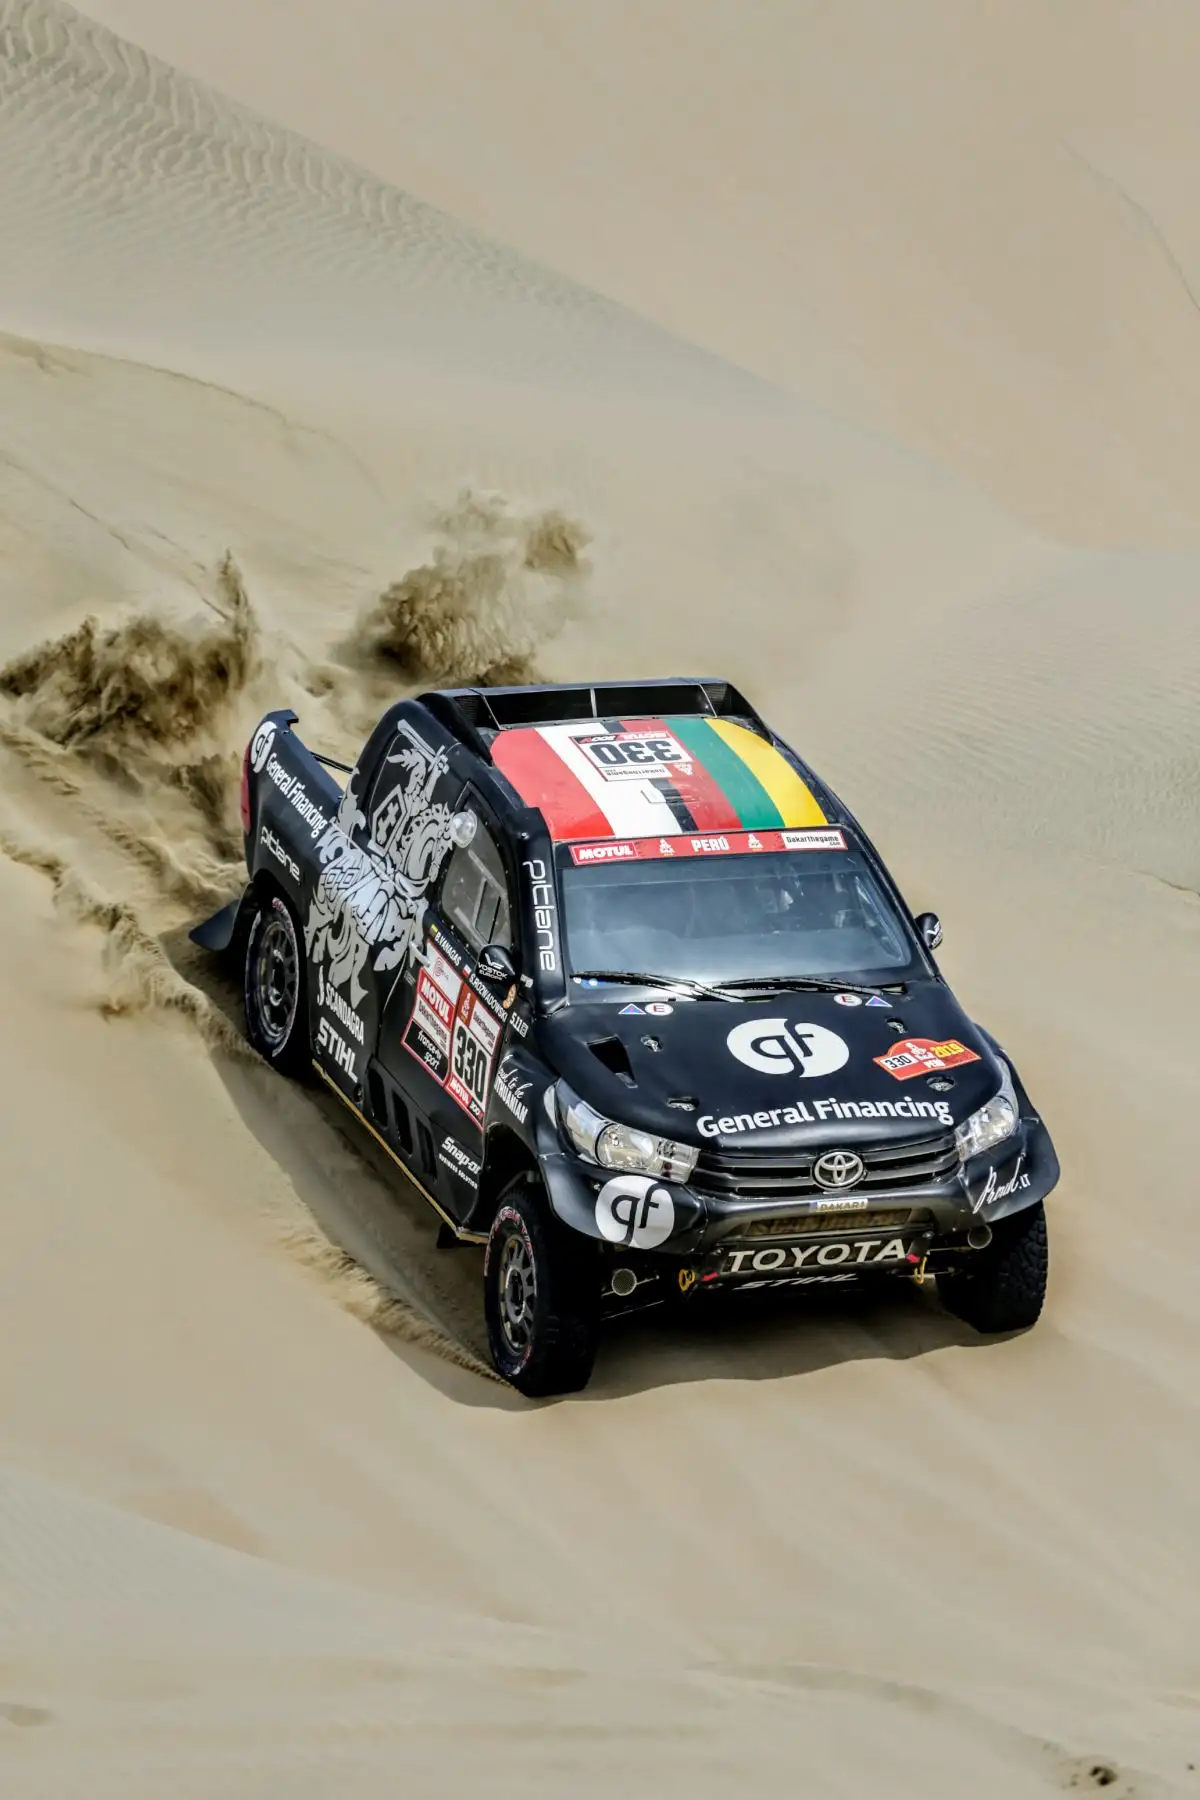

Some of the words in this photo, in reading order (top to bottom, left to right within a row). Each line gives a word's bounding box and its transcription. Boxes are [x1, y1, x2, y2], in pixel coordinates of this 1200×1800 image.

[589, 740, 683, 765] 330
[266, 752, 297, 797] General
[289, 784, 329, 839] Financing
[260, 826, 301, 882] pitlane
[578, 845, 634, 861] MOTUL
[690, 836, 730, 852] PERÚ
[522, 860, 556, 971] pitlane
[478, 962, 508, 979] VOSTOK
[326, 982, 364, 1046] SCANDAGRA
[420, 978, 450, 1023] MOTUL
[318, 1016, 358, 1084] STIHL
[454, 1025, 488, 1102] 330
[885, 1055, 912, 1069] 330
[450, 1077, 470, 1105] MOTUL
[696, 1101, 812, 1138] General
[816, 1096, 954, 1127] Financing
[728, 1238, 909, 1274] TOYOTA
[732, 1273, 860, 1291] STIHL
